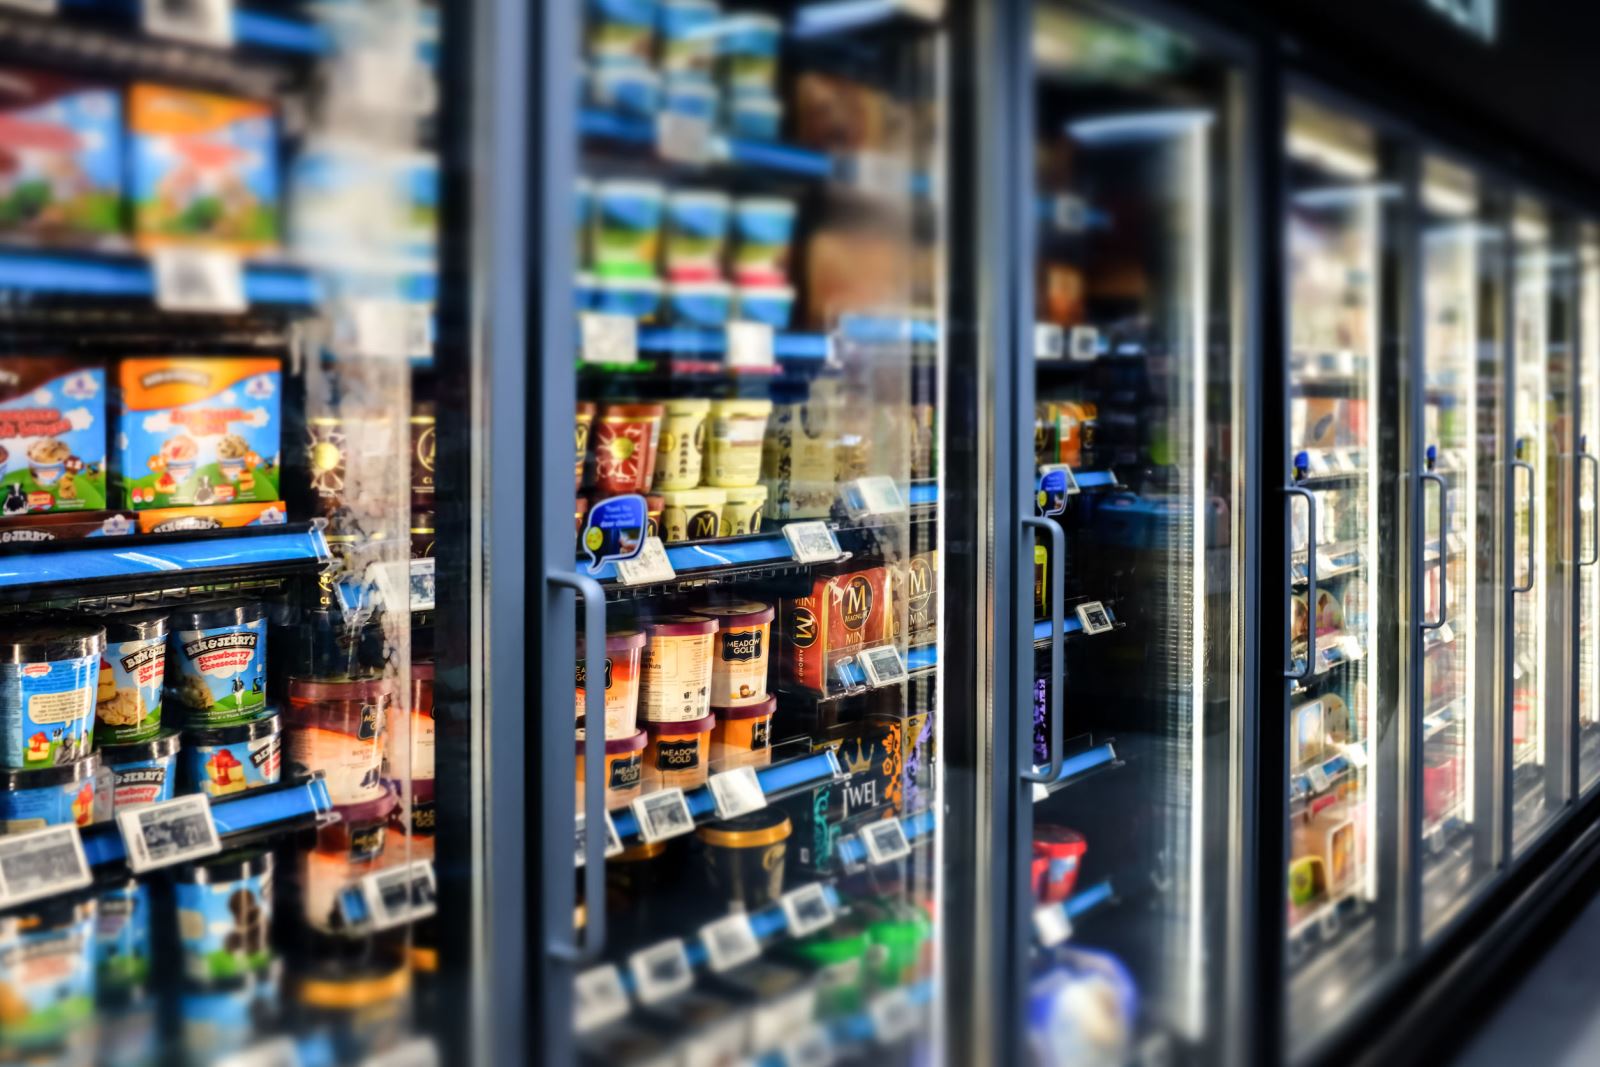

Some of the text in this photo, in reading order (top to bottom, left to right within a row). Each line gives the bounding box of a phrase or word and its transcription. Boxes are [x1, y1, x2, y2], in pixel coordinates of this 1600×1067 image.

[700, 517, 715, 536] M
[847, 585, 867, 614] M
[726, 637, 760, 649] MEADOW
[733, 645, 755, 654] GOLD
[661, 748, 698, 758] MEADOW
[668, 754, 691, 764] GOLD
